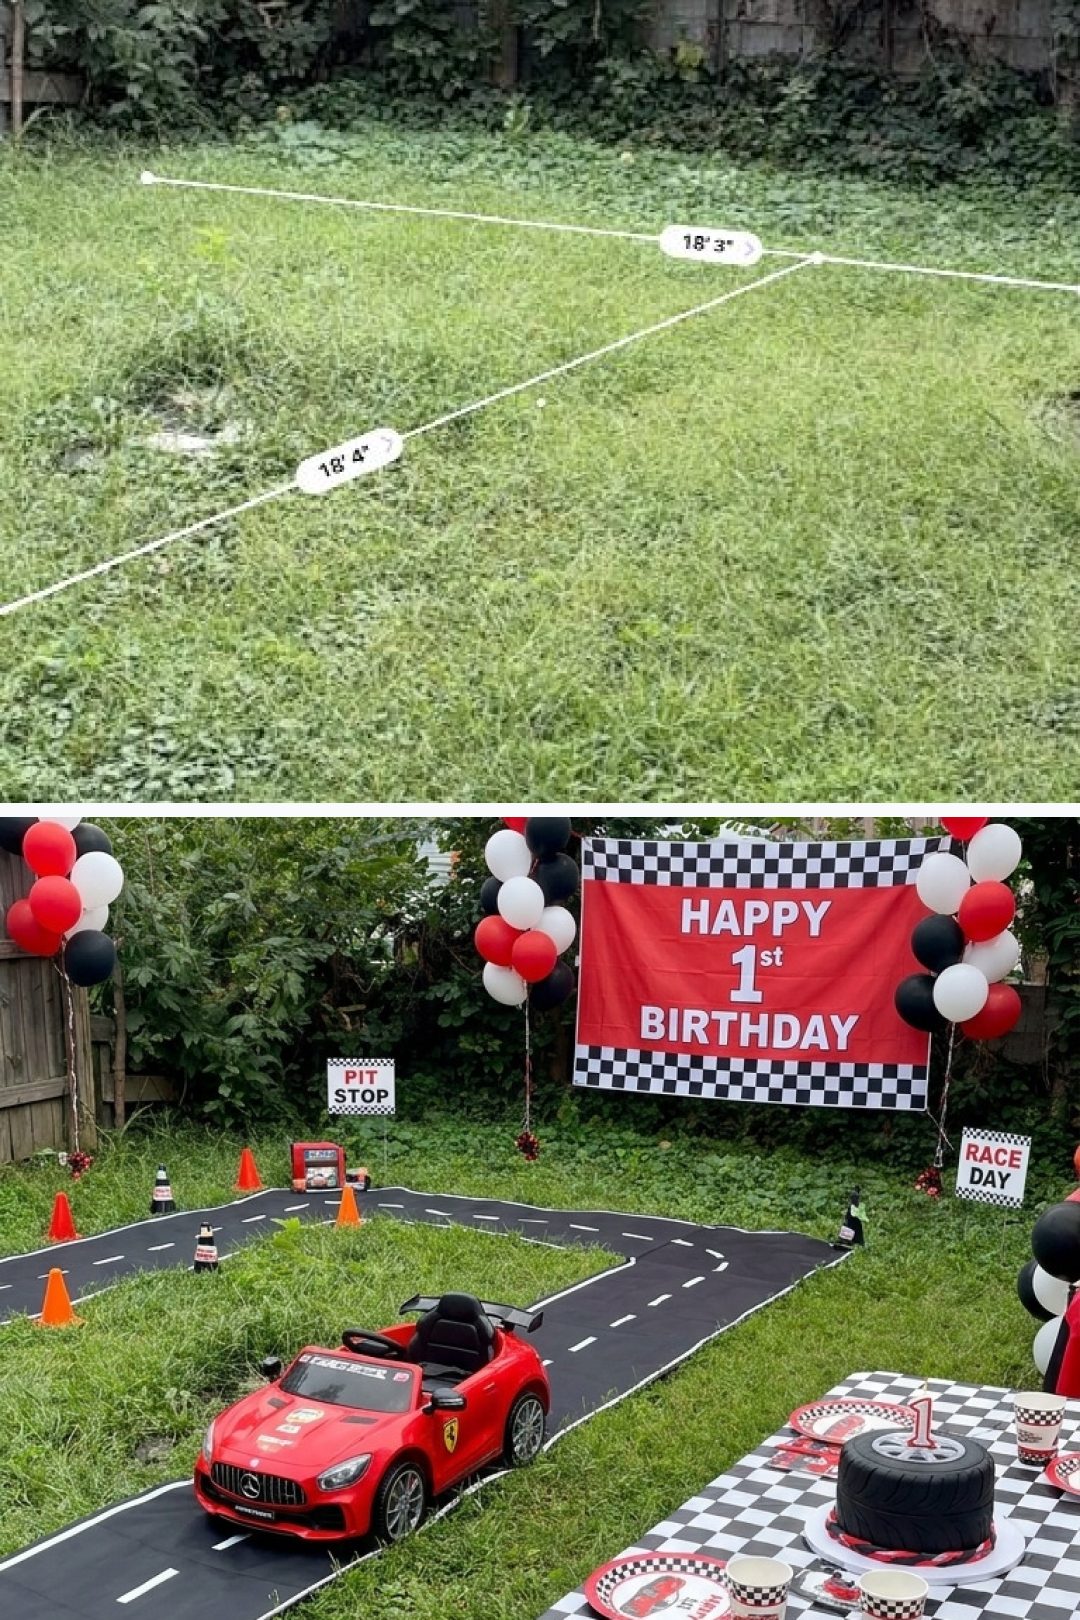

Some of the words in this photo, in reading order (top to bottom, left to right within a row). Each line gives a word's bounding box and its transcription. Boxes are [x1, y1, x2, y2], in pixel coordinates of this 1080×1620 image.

[681, 898, 832, 937] HAPPY
[730, 944, 783, 1004] 1st
[640, 1005, 860, 1051] BIRTHDAY
[345, 1070, 378, 1084] PIT
[334, 1088, 389, 1103] STOP
[965, 1143, 1022, 1169] RACE
[969, 1166, 1011, 1189] DAY
[906, 1397, 937, 1449] 1
